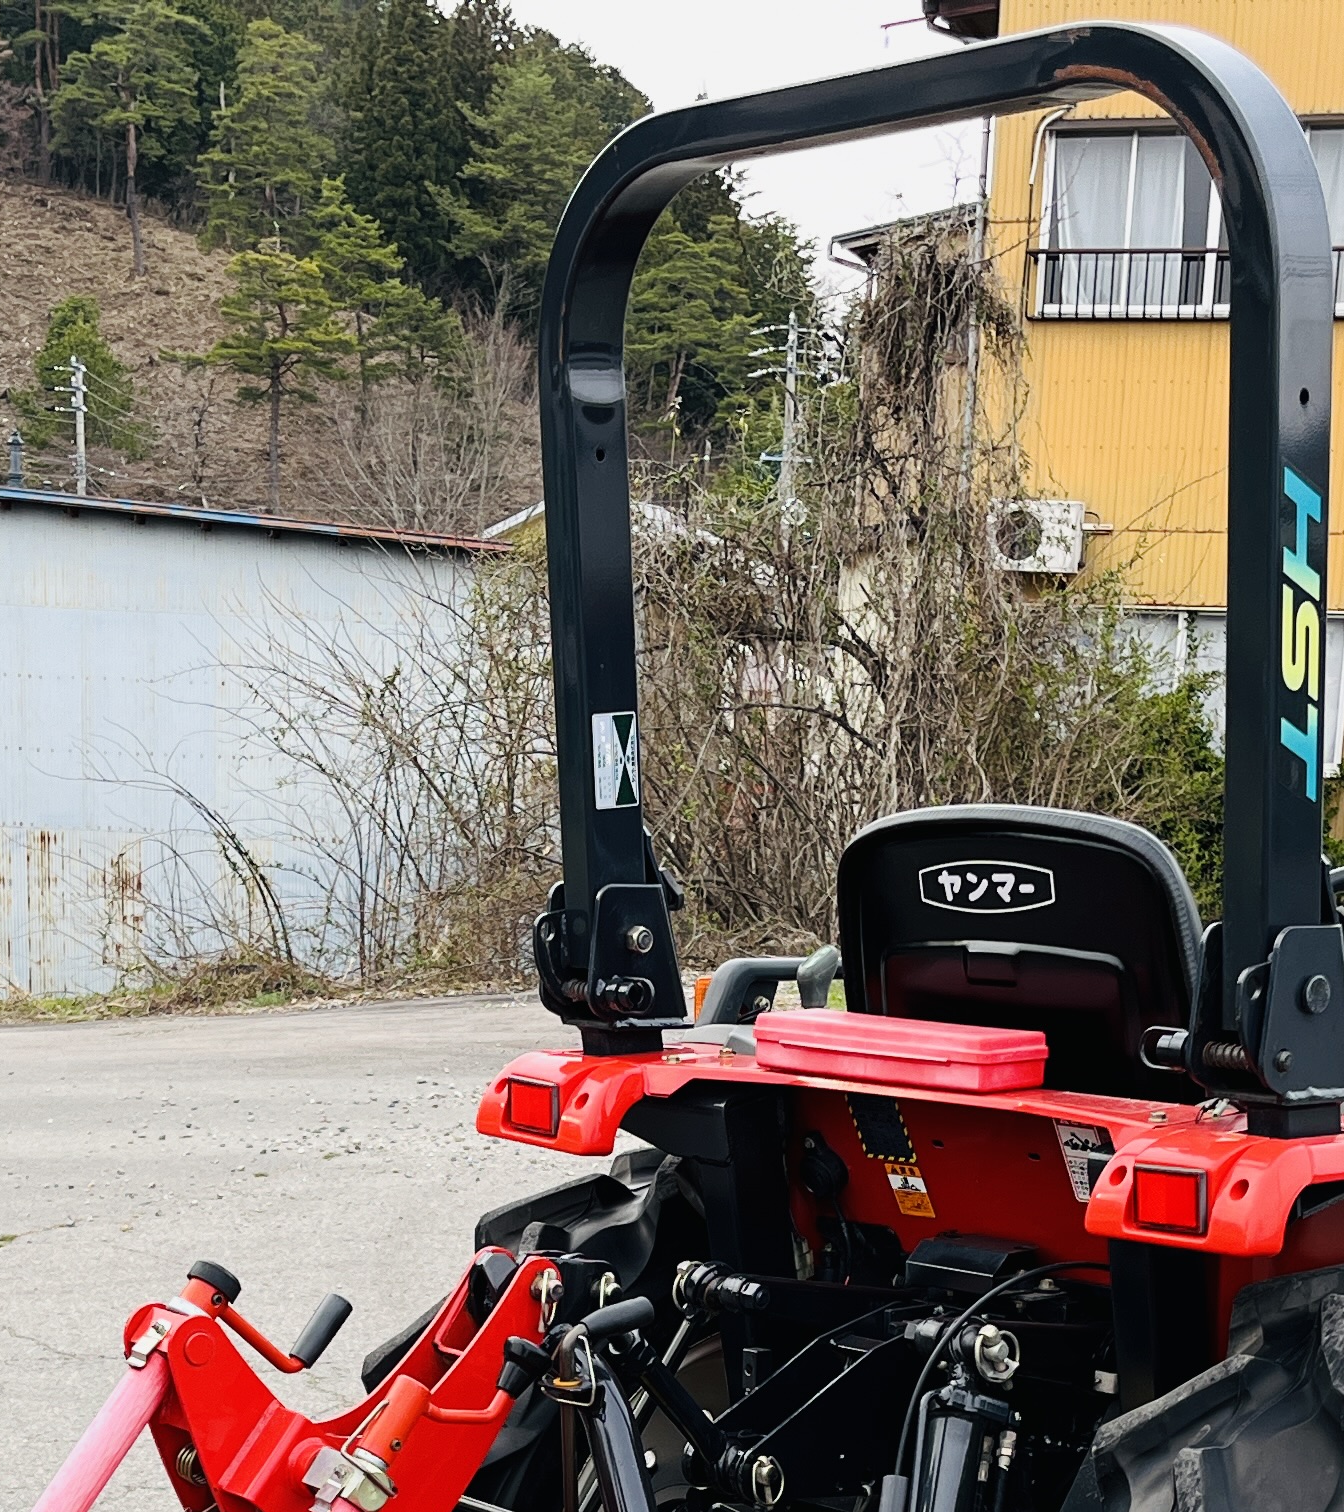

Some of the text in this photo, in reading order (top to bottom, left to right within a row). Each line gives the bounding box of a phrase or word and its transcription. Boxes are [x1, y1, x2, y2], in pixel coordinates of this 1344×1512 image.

[1281, 466, 1322, 802] HST
[938, 869, 1035, 903] ヤンマー
